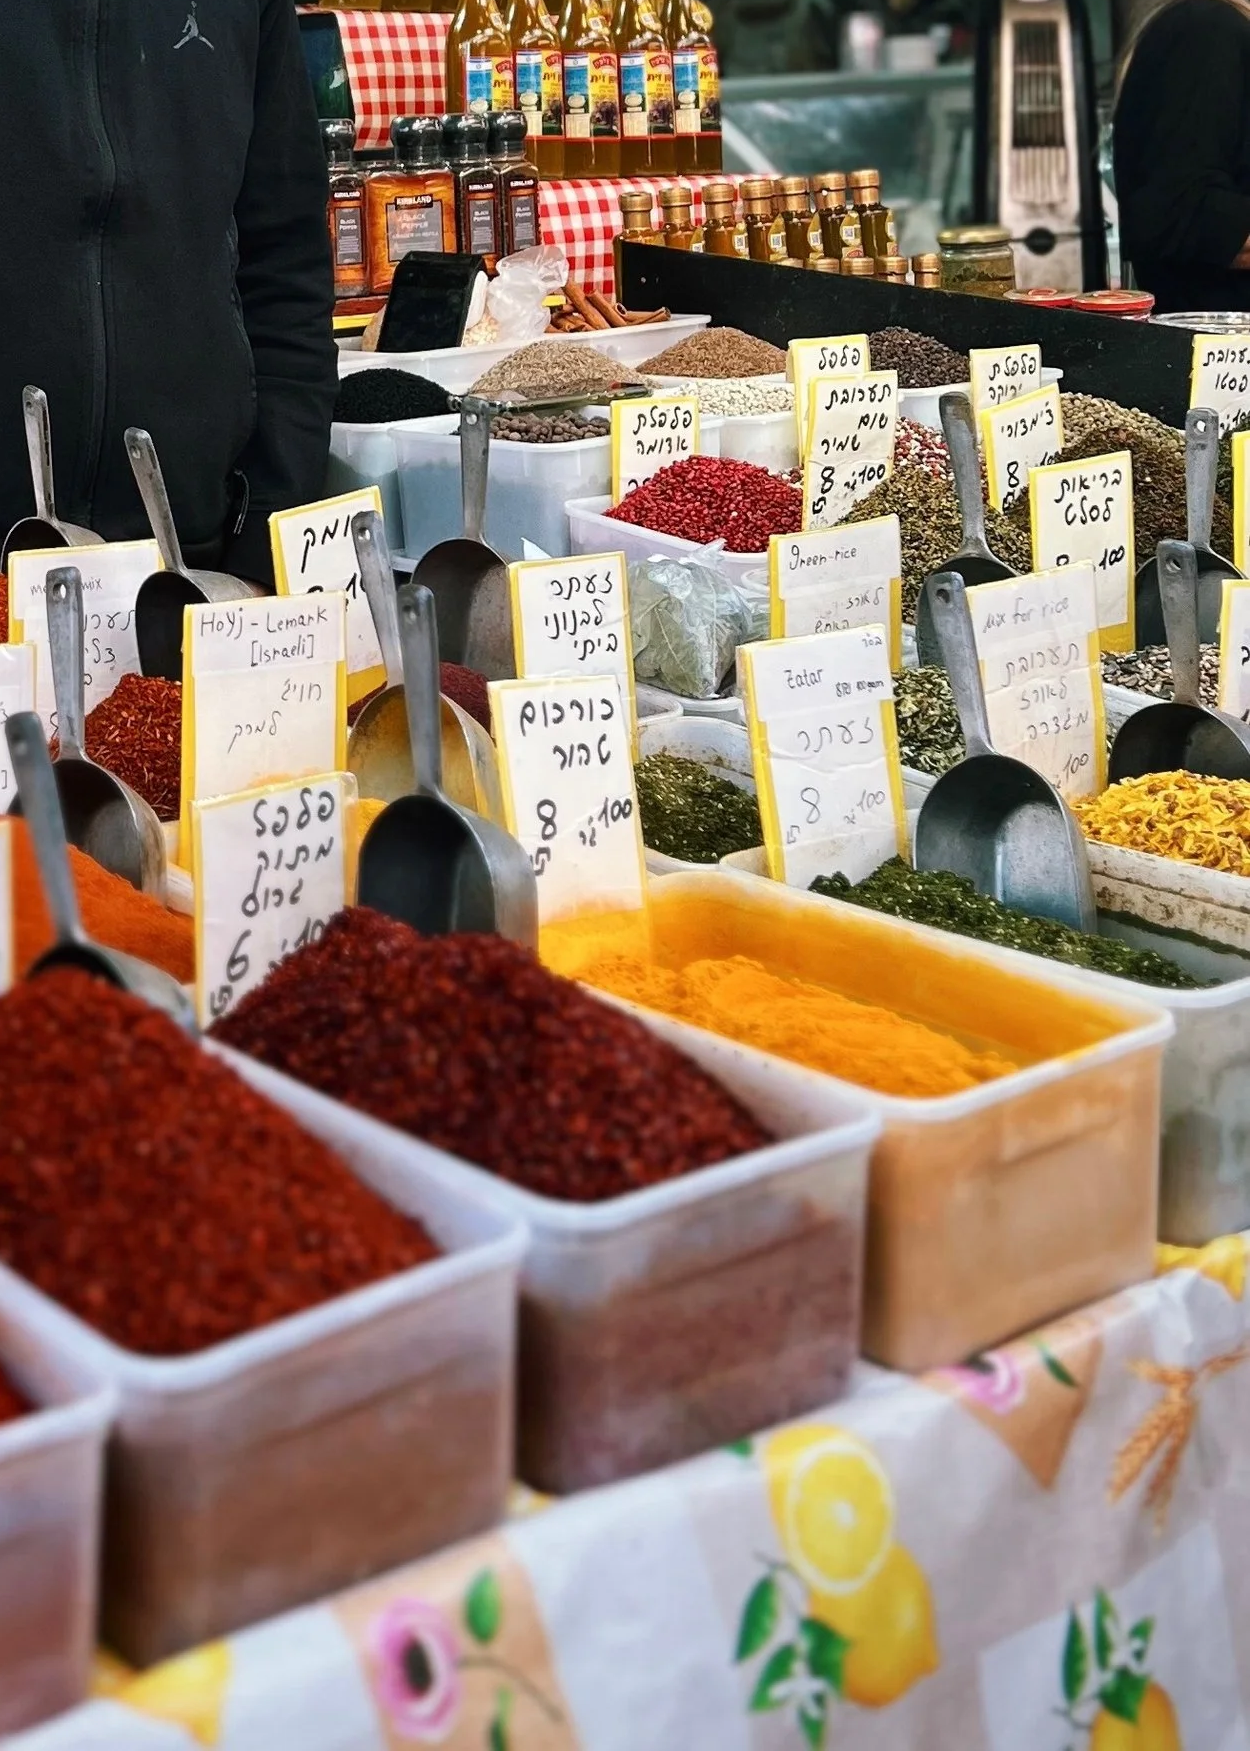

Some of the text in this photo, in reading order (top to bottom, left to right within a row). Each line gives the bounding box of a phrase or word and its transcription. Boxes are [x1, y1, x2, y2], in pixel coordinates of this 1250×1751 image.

[396, 195, 432, 205] KIRKLAND
[818, 346, 861, 371] פלפל
[988, 354, 1037, 382] פלפלת
[824, 384, 892, 411] תערובת
[632, 405, 693, 436] פלפלת
[857, 411, 888, 433] שום
[636, 435, 689, 456] אדומה
[820, 434, 862, 456] שמיר
[820, 463, 886, 495] 100 8
[1006, 460, 1020, 488] 8
[1054, 468, 1123, 504] בריאות
[1065, 496, 1115, 527] לסלט
[301, 514, 350, 574] ומק
[1098, 546, 1126, 569] 100
[549, 571, 613, 601] זעתר
[265, 607, 329, 634] Lemark
[544, 598, 605, 640] לבנוני
[1013, 595, 1034, 625] for
[1039, 596, 1071, 619] rice
[573, 632, 619, 661] ביתי
[1001, 641, 1080, 687] תערובת
[227, 710, 283, 754] למרק
[519, 697, 615, 738] כורכום
[797, 717, 874, 754] זעתר
[552, 733, 612, 771] טהור
[1063, 752, 1089, 782] 100
[253, 787, 335, 837] פלפל
[536, 795, 634, 842] 100 8
[800, 787, 886, 825] 100 8
[225, 929, 252, 984] 6
